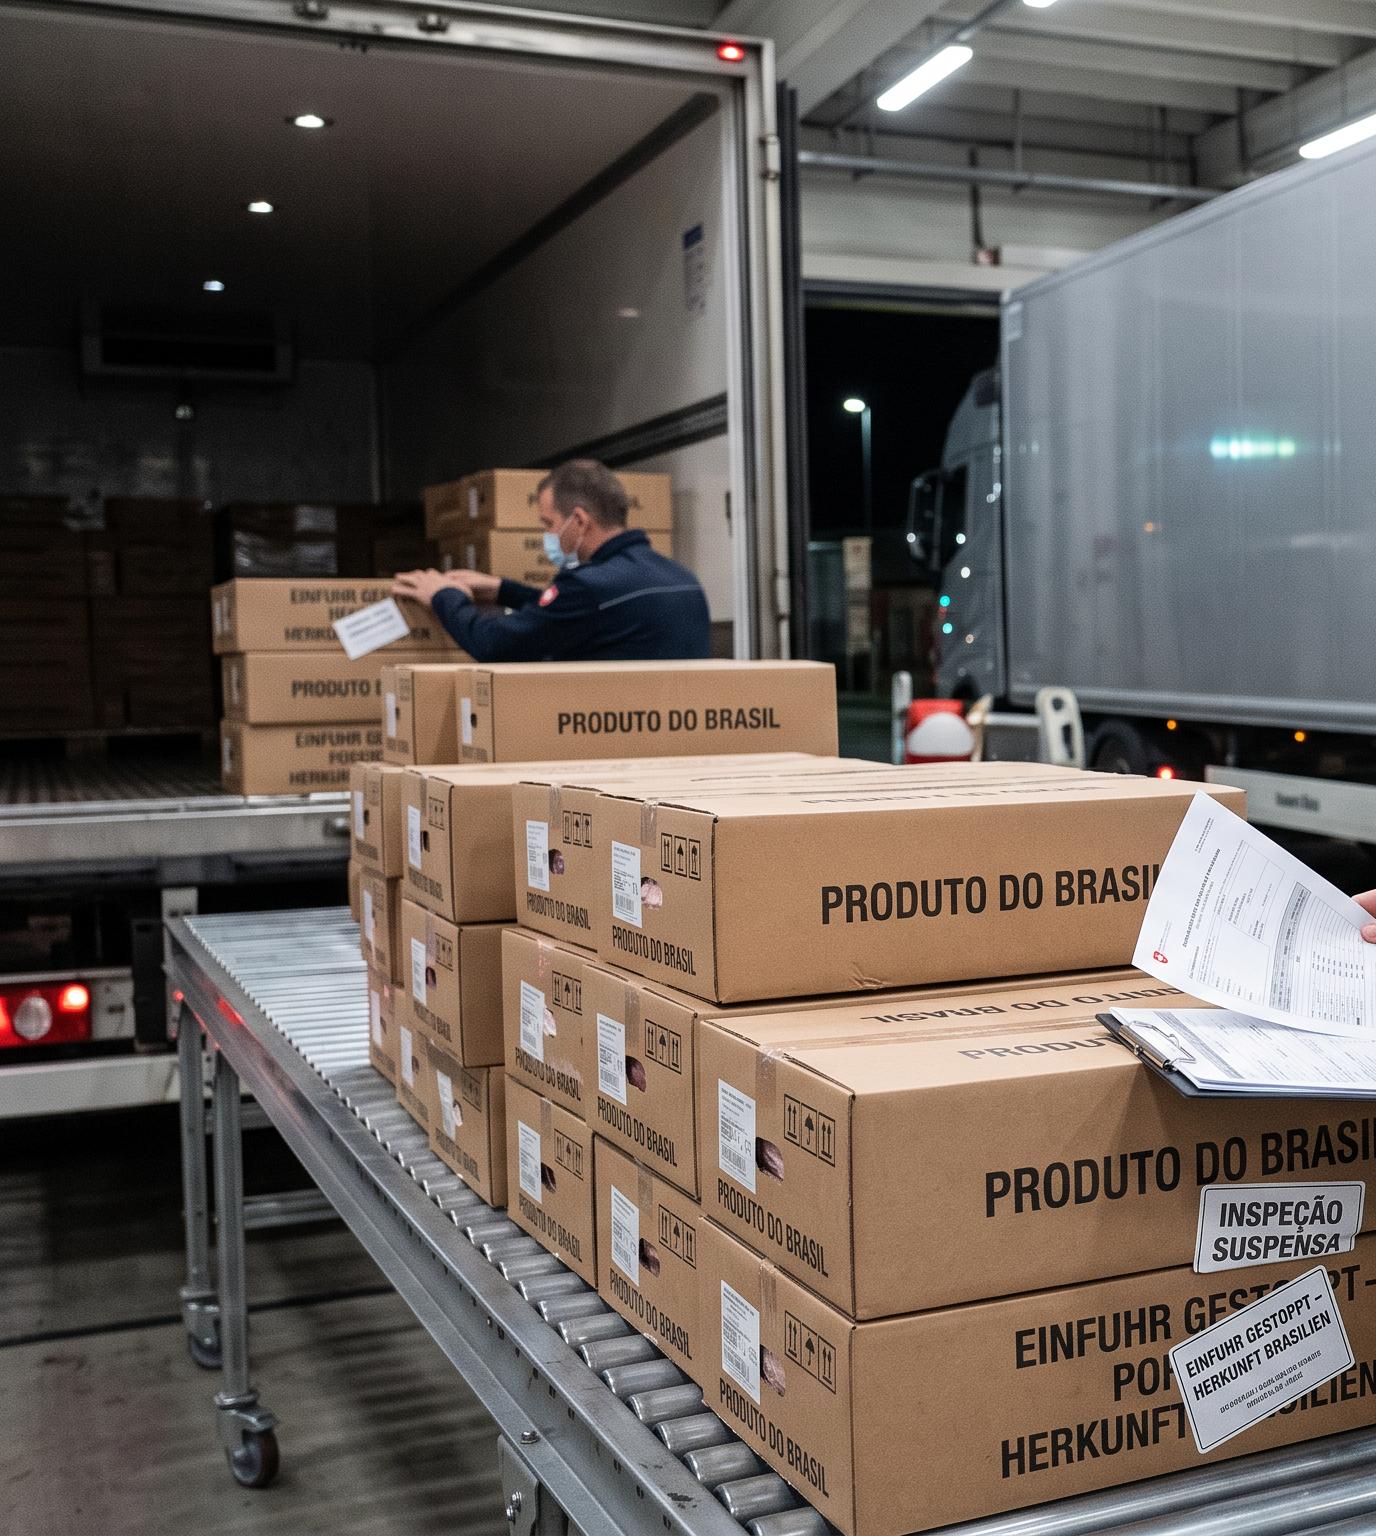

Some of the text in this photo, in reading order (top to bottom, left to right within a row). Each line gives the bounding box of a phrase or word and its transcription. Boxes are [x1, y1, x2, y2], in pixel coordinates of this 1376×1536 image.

[557, 707, 781, 735] PRODUTO DO BRASIL
[822, 876, 987, 925] PRODUTO
[1000, 872, 1043, 911] DO
[650, 937, 663, 964] DO
[663, 942, 697, 976] BRASIL
[597, 1096, 678, 1167] PRODUTO DO BRASIL
[985, 1145, 1182, 1218] PRODUTO
[1195, 1136, 1247, 1186] DO
[718, 1178, 829, 1279] PRODUTO DO BRASIL
[1212, 1233, 1341, 1262] SUSPENSA
[1219, 1195, 1344, 1233] INSPEÇÃO
[646, 1297, 659, 1332] DO
[659, 1311, 693, 1361] BRASIL
[1015, 1304, 1173, 1370] EINFUHR
[1185, 1334, 1245, 1379] EINFUHR
[1245, 1294, 1311, 1345] GESTOPPT
[1192, 1348, 1262, 1401] HERKUNFT
[1263, 1310, 1332, 1361] BRASILIEN
[719, 1377, 830, 1499] PRODUTO DO BRASIL
[1001, 1402, 1187, 1479] HERKUNFT
